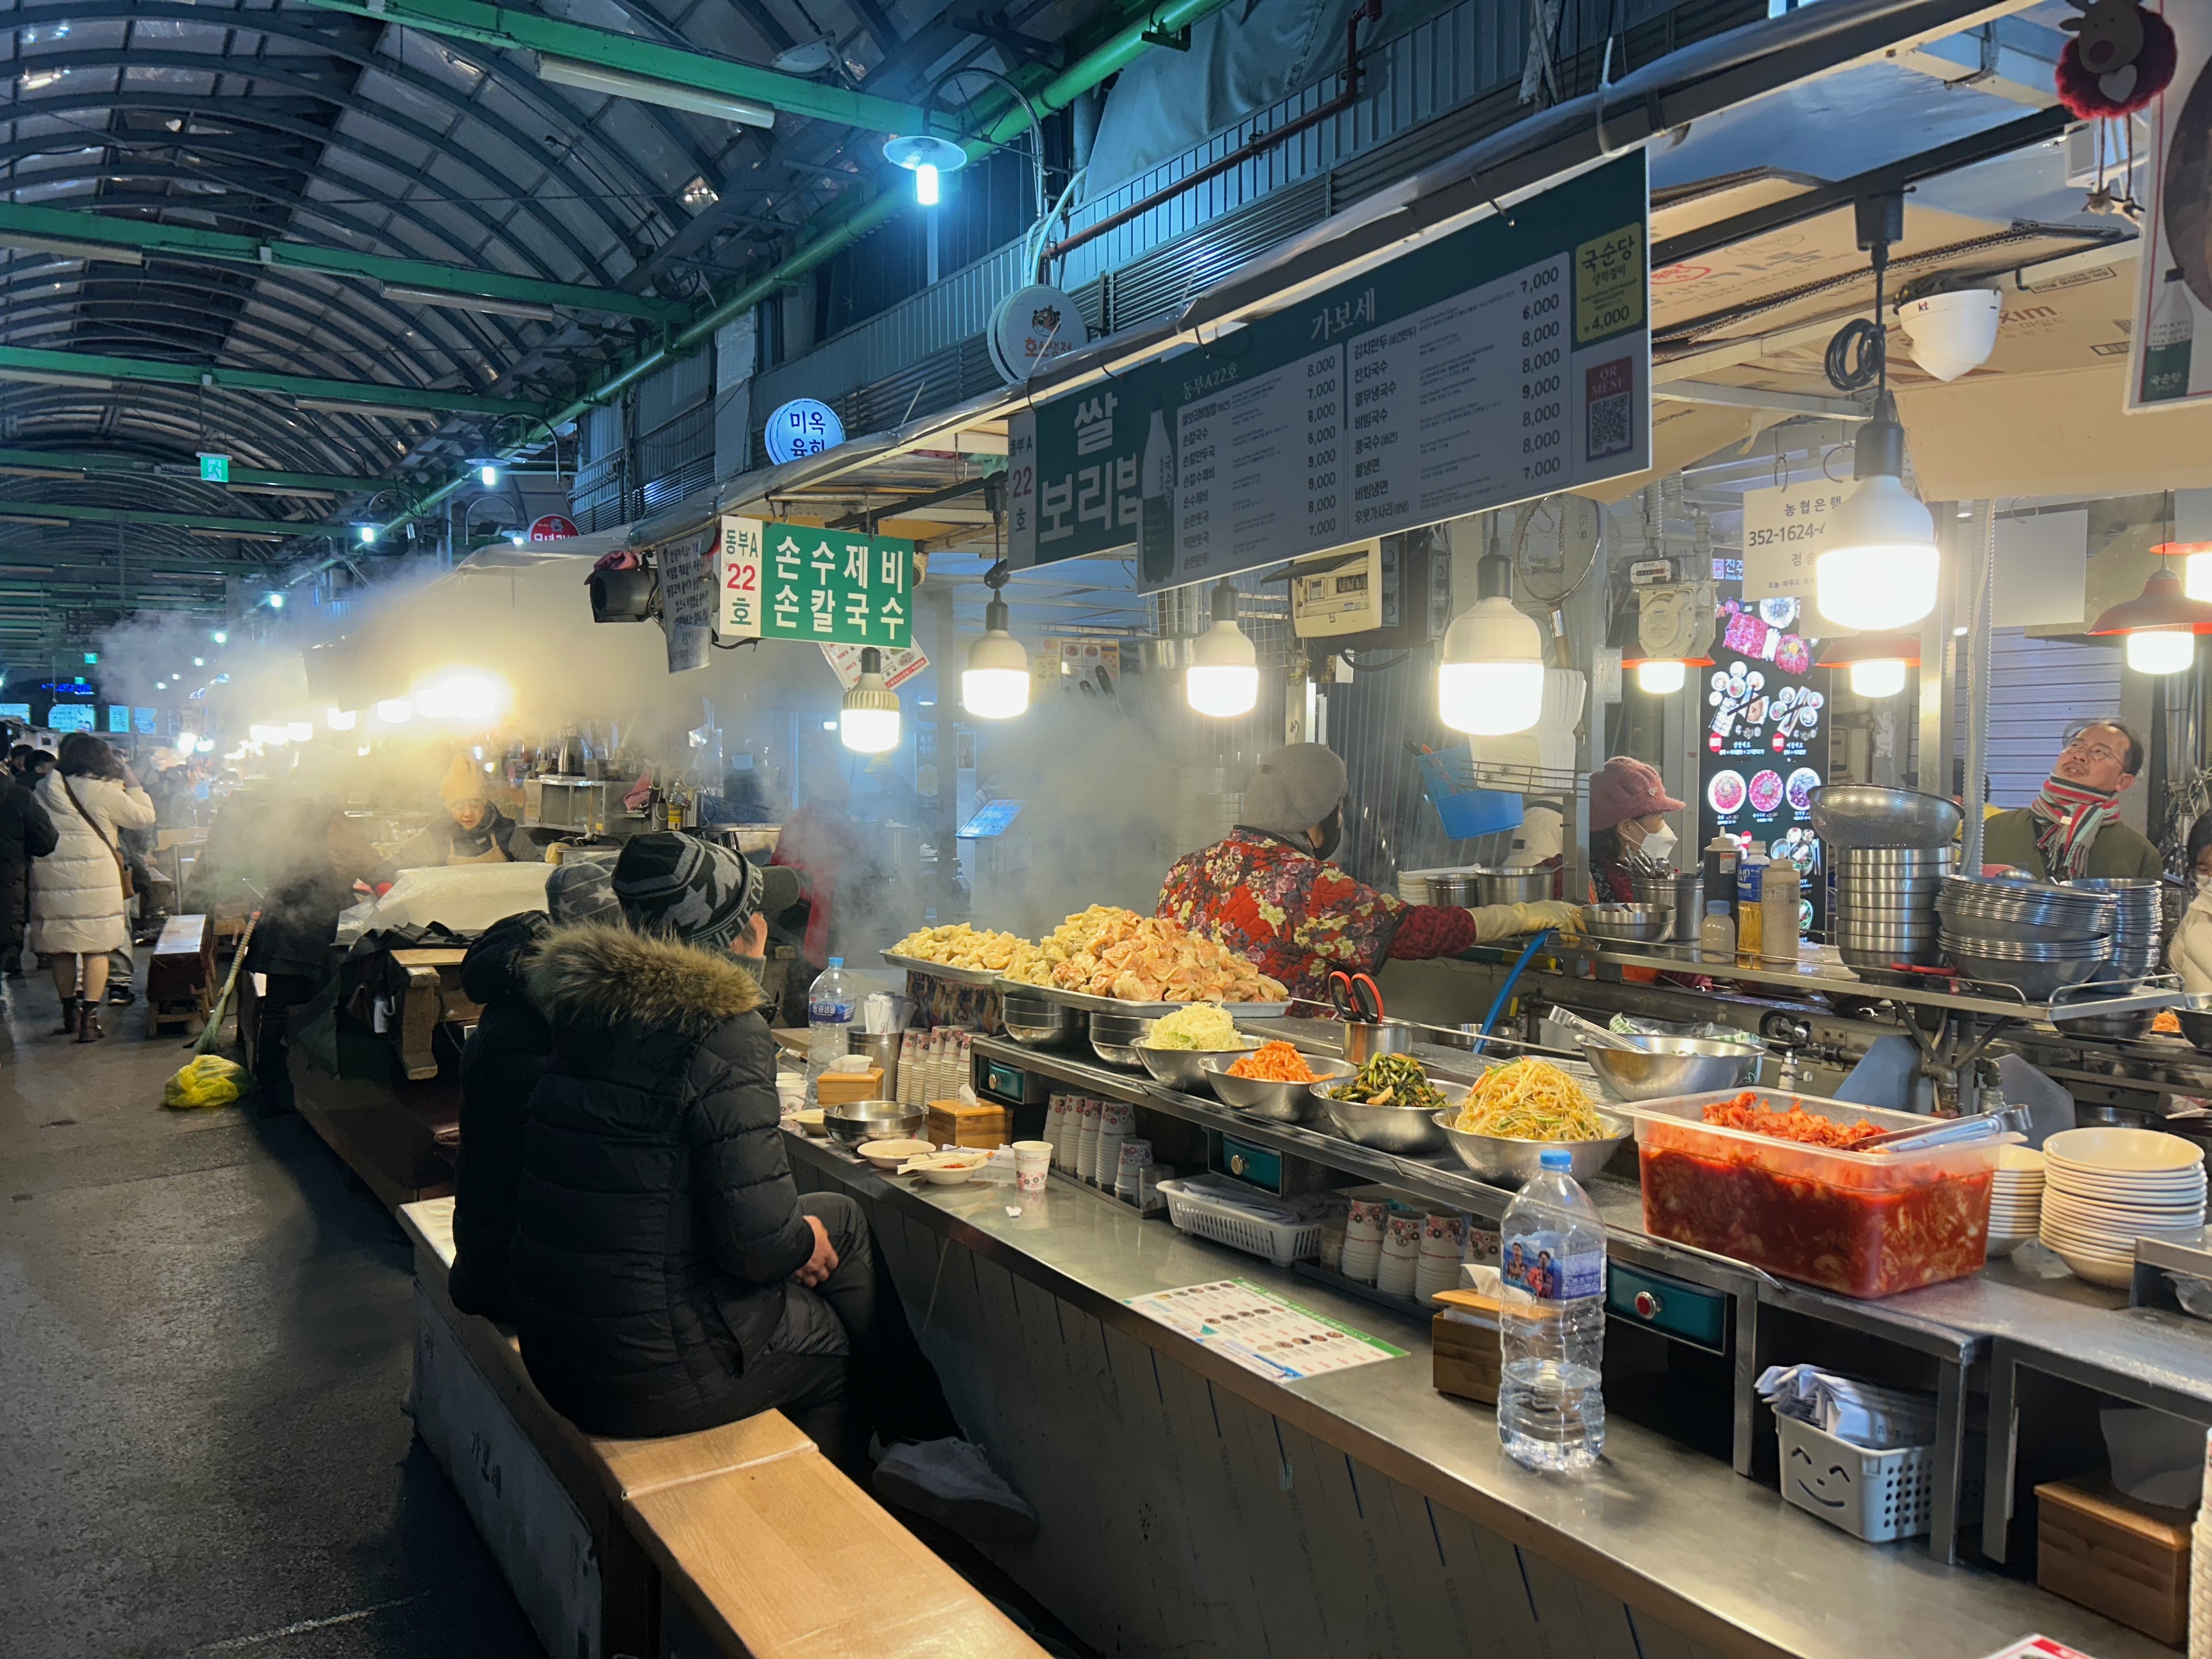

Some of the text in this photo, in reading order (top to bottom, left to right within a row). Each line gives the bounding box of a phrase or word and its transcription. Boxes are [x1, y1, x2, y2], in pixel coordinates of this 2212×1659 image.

[1582, 235, 1635, 272] 국순당
[1311, 287, 1375, 340] 가보세
[1355, 335, 1387, 360] 김치만두
[1520, 266, 1559, 294] 7,000
[1592, 306, 1629, 330] 4,000
[1918, 302, 1929, 312] kt
[1355, 359, 1389, 384] 잔치국수
[1522, 294, 1559, 320] 6,000
[1307, 356, 1335, 377] 8,000
[1355, 381, 1397, 408] 열무냉국수
[1522, 320, 1560, 347] 8,000
[1600, 368, 1618, 380] QR
[1183, 363, 1239, 400] 동부A22호
[1355, 408, 1389, 430] 비빔국수
[1522, 348, 1560, 374] 8,000
[1522, 375, 1560, 400] 9,000
[1591, 377, 1625, 396] MENU
[791, 410, 826, 436] 미옥
[1074, 391, 1118, 456] 쌀
[1183, 380, 1335, 447] 손칼국수 7,000
[1308, 403, 1335, 423] 8,000
[791, 438, 825, 457] 육회
[1011, 435, 1033, 457] 동부A
[1355, 457, 1380, 479] 물냉면
[1522, 402, 1560, 428] 8,000
[1183, 467, 1215, 488] 손칼수제비
[1308, 426, 1335, 446] 8,000
[1355, 429, 1561, 501] 비빔냉면 8,000
[1523, 456, 1561, 480] 7,000
[1013, 466, 1031, 498] 22
[1183, 489, 1209, 509] 손수제비
[1308, 449, 1336, 468] 9,000
[1308, 472, 1336, 491] 8,000
[1308, 495, 1336, 515] 8,000
[1785, 495, 1841, 516] 농협은행
[1015, 508, 1026, 533] 호
[1308, 518, 1336, 537] 7,000
[725, 529, 758, 557] 동부A
[727, 563, 755, 590] 22
[775, 535, 903, 594] 손수제비
[730, 598, 752, 625] 호
[774, 585, 904, 640] 손칼국수
